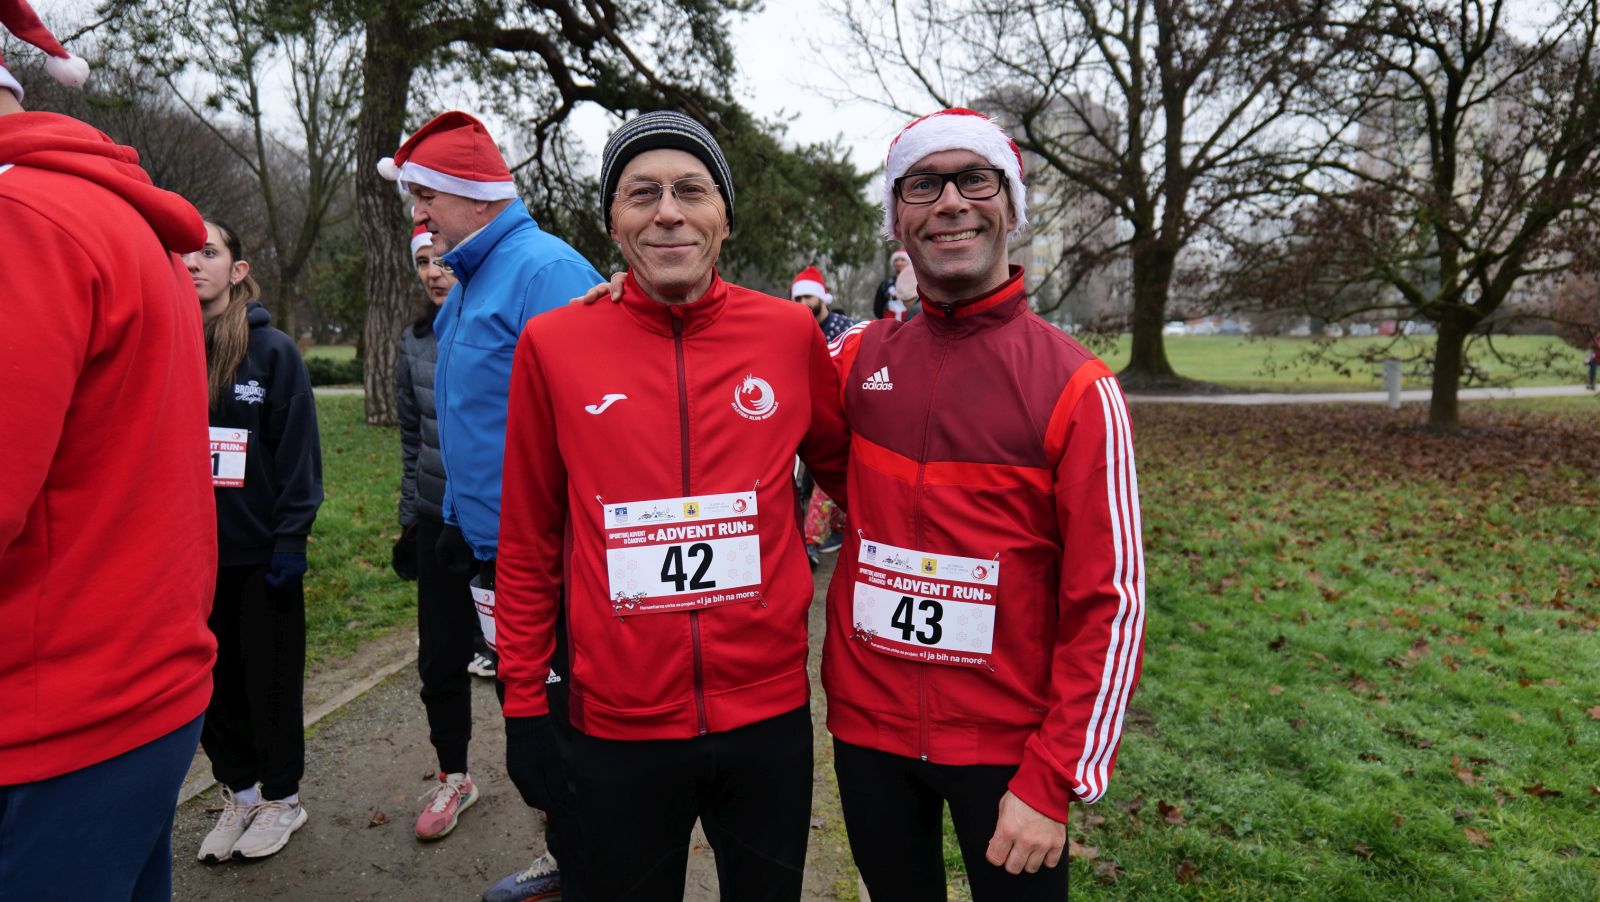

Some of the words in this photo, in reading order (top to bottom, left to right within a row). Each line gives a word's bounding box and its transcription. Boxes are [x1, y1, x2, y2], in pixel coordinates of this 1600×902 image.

[234, 384, 266, 398] BROOKL
[862, 380, 893, 390] adidas
[647, 523, 715, 541] «ADVENT
[718, 520, 754, 535] RUN»
[661, 542, 716, 592] 42
[887, 576, 951, 597] «ADVENT
[952, 585, 992, 601] RUN»
[704, 596, 712, 605] ja
[712, 594, 725, 603] bih
[891, 595, 944, 646] 43
[927, 651, 935, 660] ja
[936, 652, 949, 661] bih
[950, 655, 960, 663] na
